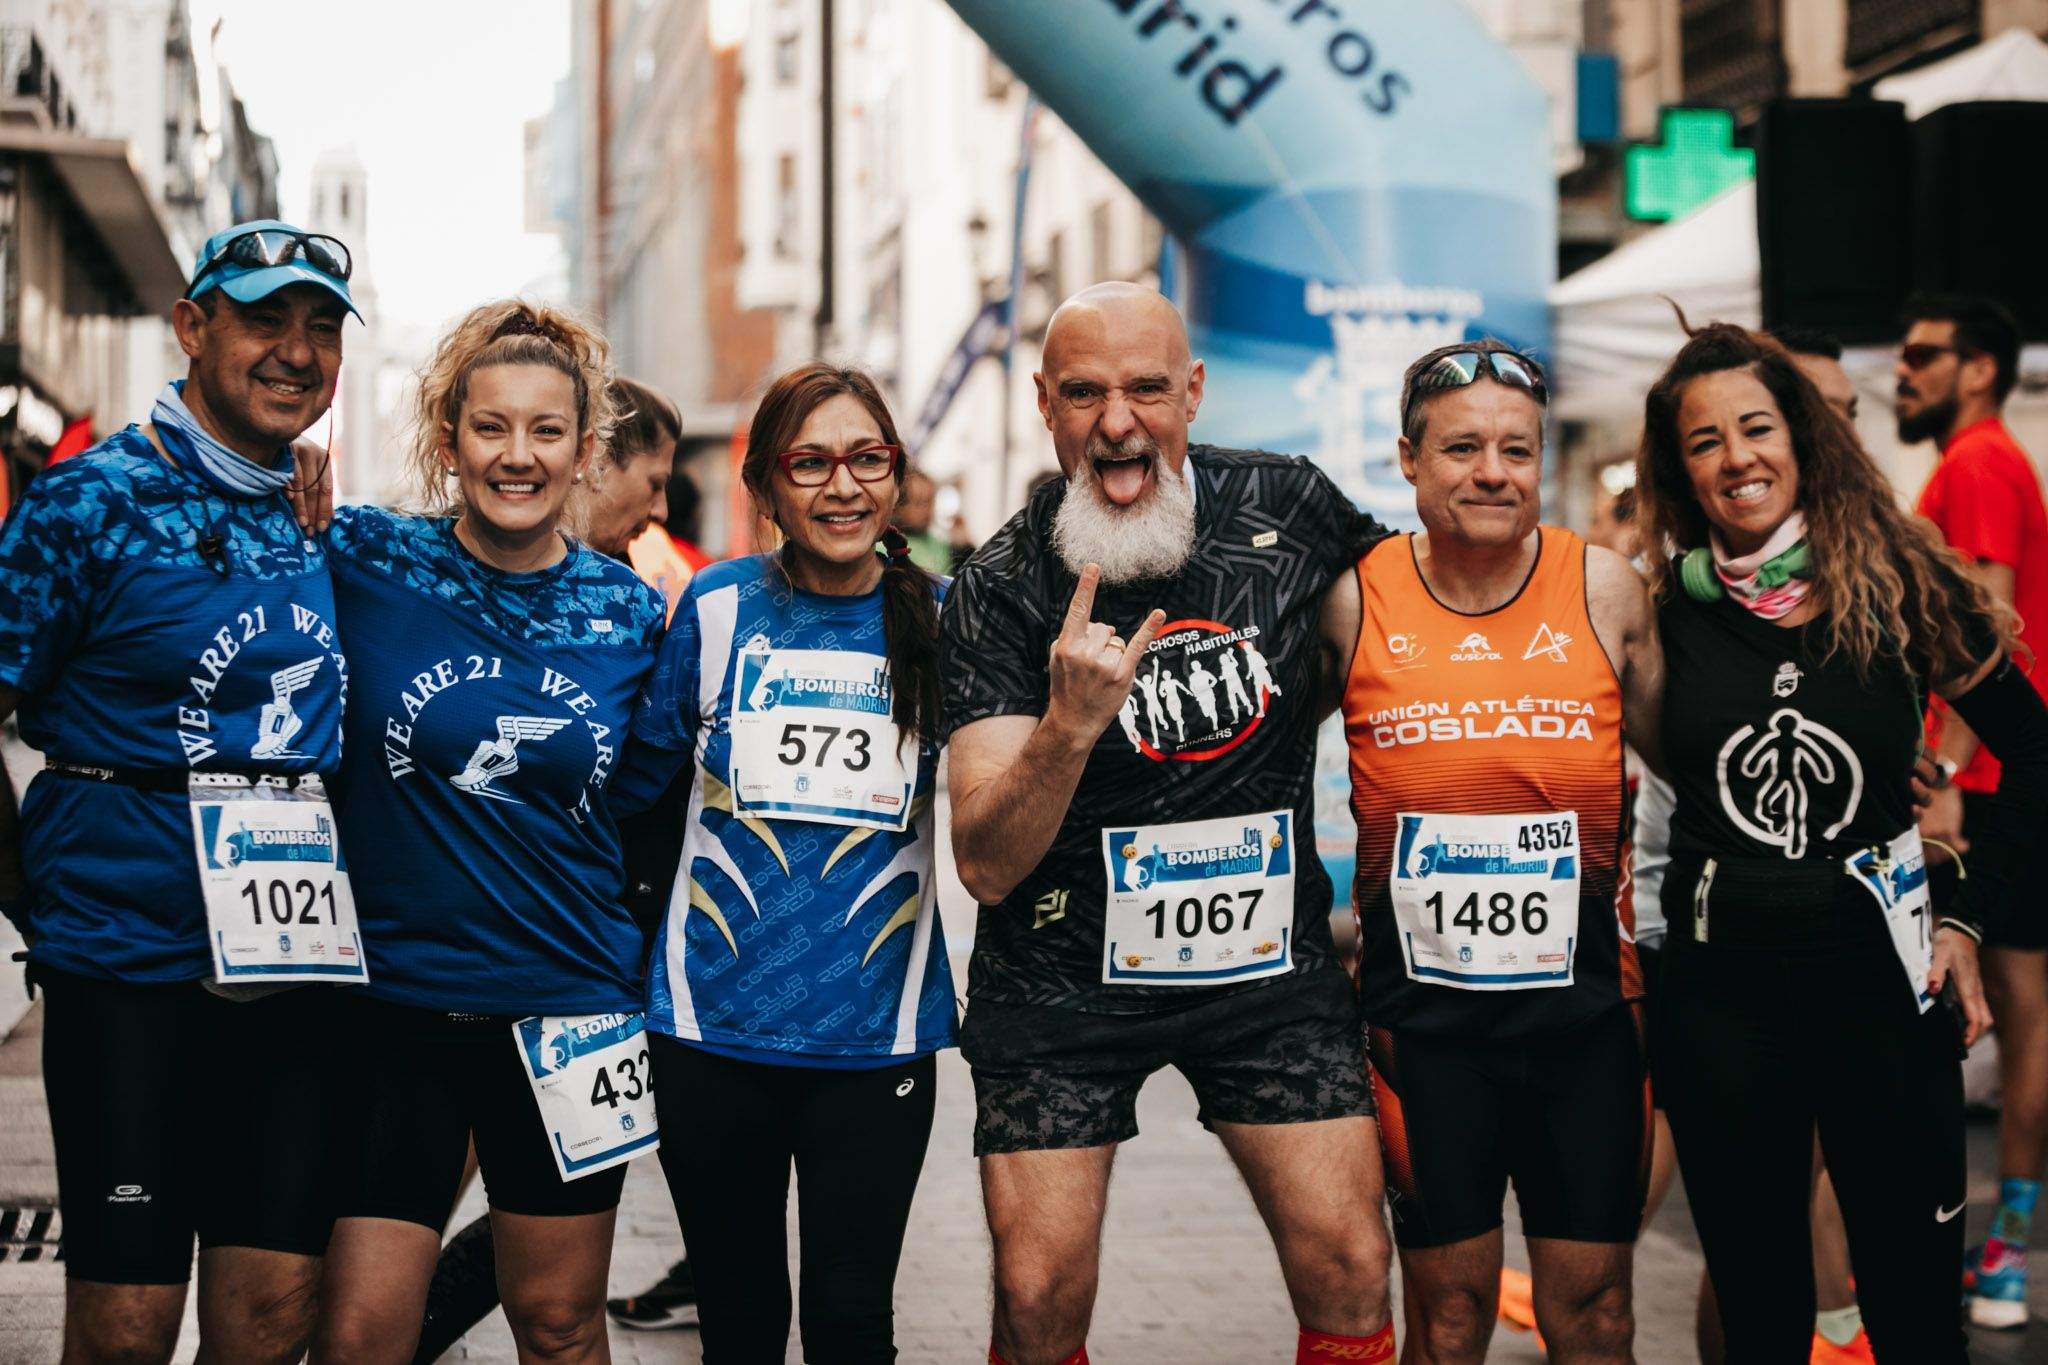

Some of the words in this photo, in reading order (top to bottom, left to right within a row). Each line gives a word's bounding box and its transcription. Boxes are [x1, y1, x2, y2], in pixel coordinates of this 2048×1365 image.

[1272, 0, 1411, 114] ros
[237, 604, 268, 643] 21
[289, 602, 334, 650] WE
[1144, 629, 1200, 654] CHOSOS
[1184, 624, 1261, 656] HABITUALES
[189, 625, 241, 705] ARE
[794, 678, 889, 700] BOMBEROS
[828, 695, 844, 708] de
[849, 696, 889, 714] MADRID
[384, 716, 416, 781] WE
[400, 658, 460, 723] ARE
[464, 654, 503, 681] 21
[539, 667, 598, 716] WE
[585, 718, 614, 790] ARE
[1368, 700, 1449, 726] UNIÓN
[1459, 694, 1596, 717] ATLÉTICA
[176, 705, 218, 768] WE
[777, 723, 871, 772] 573
[1373, 715, 1594, 750] COSLADA
[253, 831, 331, 847] BOMBEROS
[1167, 843, 1260, 866] BOMBEROS
[1517, 820, 1574, 853] 4352
[1205, 861, 1218, 877] de
[1220, 856, 1262, 876] MADRID
[1485, 858, 1500, 873] de
[241, 879, 338, 926] 1021
[1145, 888, 1265, 939] 1067
[1425, 891, 1549, 937] 1486
